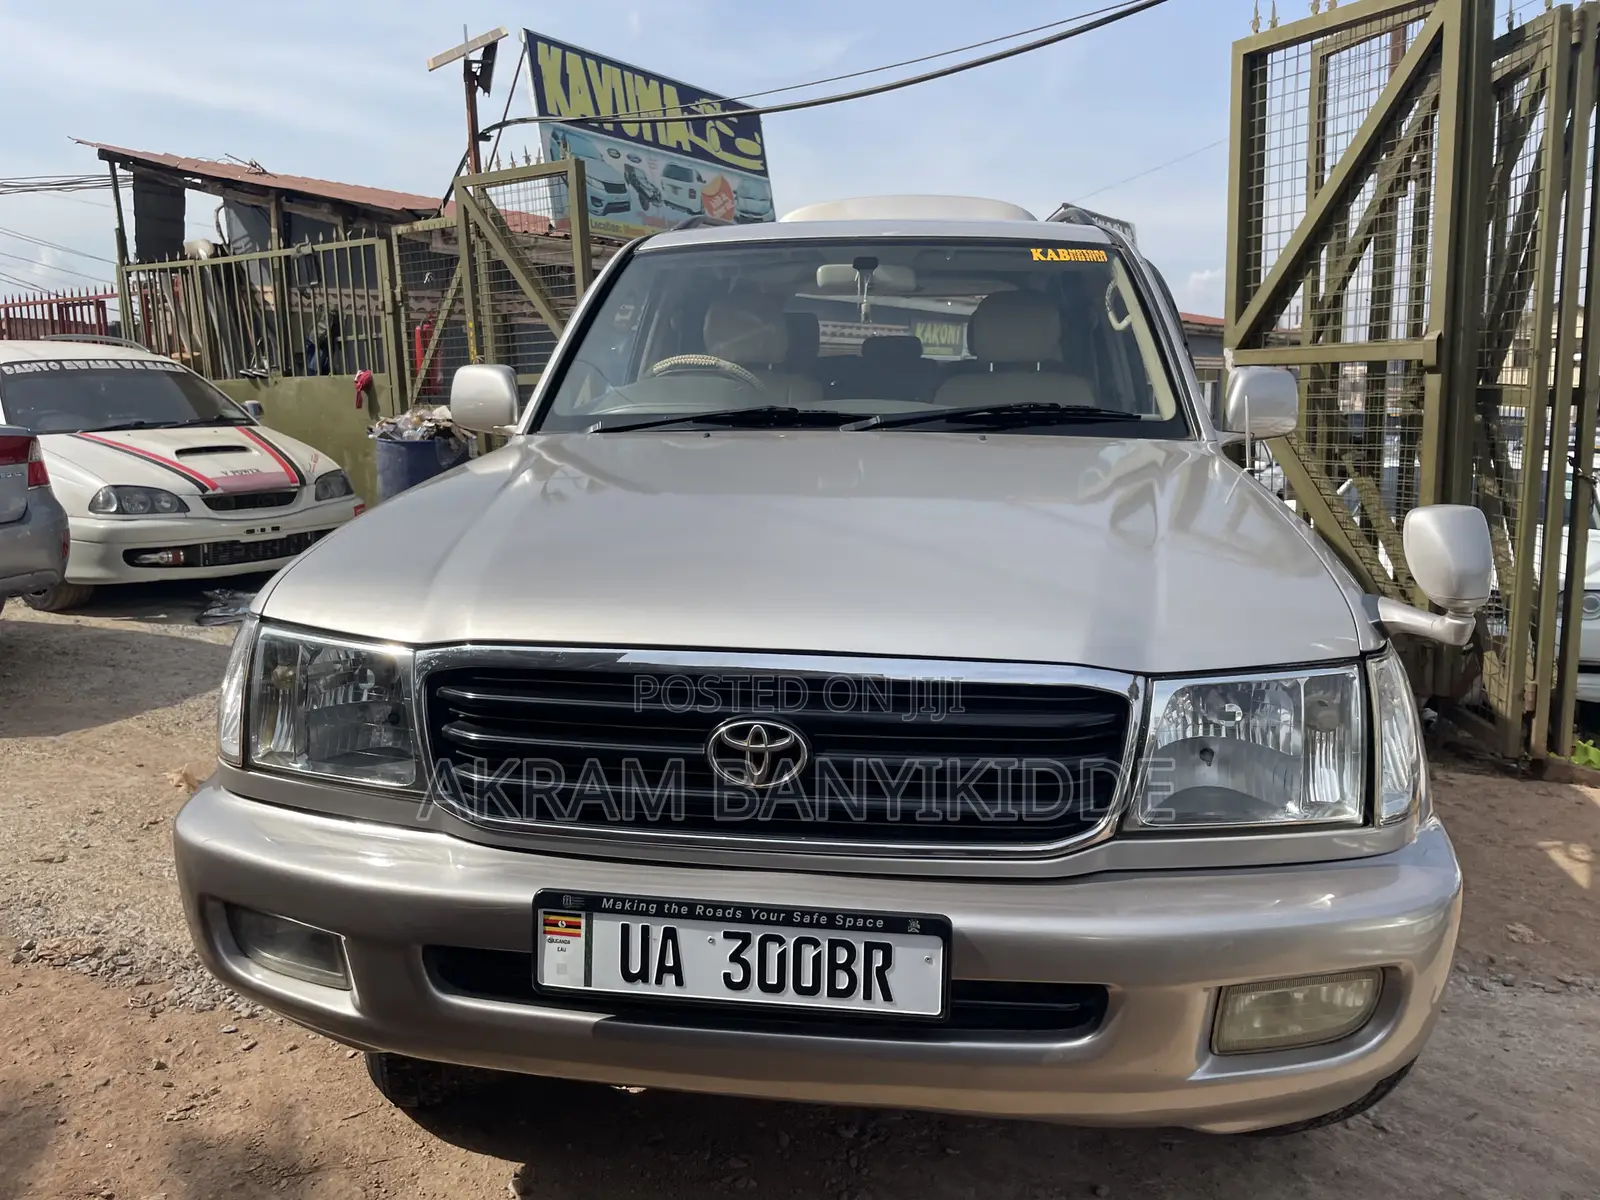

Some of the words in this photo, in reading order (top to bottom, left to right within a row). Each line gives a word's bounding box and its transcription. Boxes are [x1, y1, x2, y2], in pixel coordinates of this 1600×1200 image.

[601, 898, 657, 915] Making
[664, 903, 688, 914] the
[695, 905, 742, 918] Roads
[750, 909, 785, 921] Your
[792, 912, 827, 924] Safe
[835, 915, 884, 928] Space
[620, 922, 685, 987] UA
[721, 930, 894, 1002] 300BR
